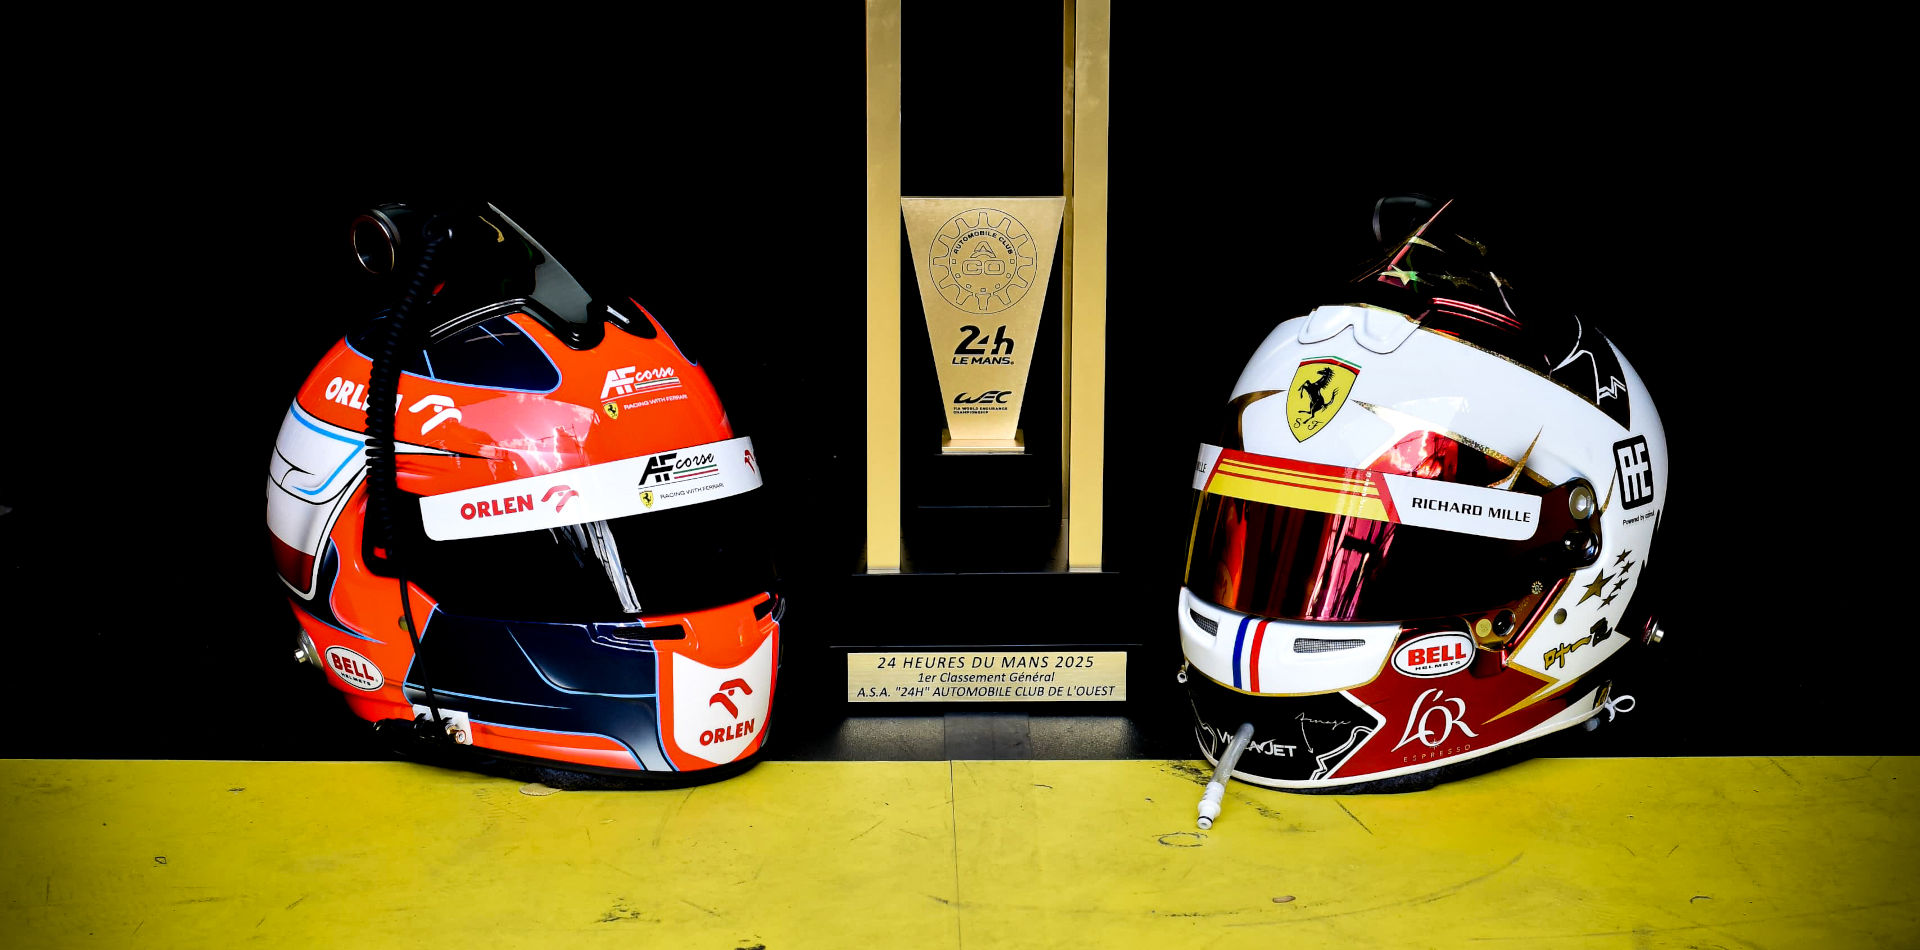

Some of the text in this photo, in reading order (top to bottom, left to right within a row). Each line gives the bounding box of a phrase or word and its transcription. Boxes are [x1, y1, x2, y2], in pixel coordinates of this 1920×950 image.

[953, 230, 1014, 255] AUTOMOBILE CLUB
[952, 356, 1011, 365] LE MANS
[600, 366, 675, 400] AF corse
[325, 376, 403, 416] ORL
[953, 390, 1013, 404] WEC
[638, 452, 715, 486] AF corse
[460, 494, 534, 520] ORLEN
[1411, 497, 1531, 523] RICHARD MILLE
[331, 652, 375, 682] BELL
[877, 656, 1094, 669] 24 HEURES DU MANS 2025
[1407, 642, 1467, 667] BELL
[1415, 660, 1461, 671] HELMETS
[918, 671, 1055, 683] 1er Classement Général
[857, 685, 1116, 698] A.S.A. "24H" AUTOMOBILE CLUB DE L'OUEST
[699, 718, 755, 747] ORLEN
[1216, 727, 1297, 757] VIAJET
[1403, 744, 1471, 763] ESPRESSO
